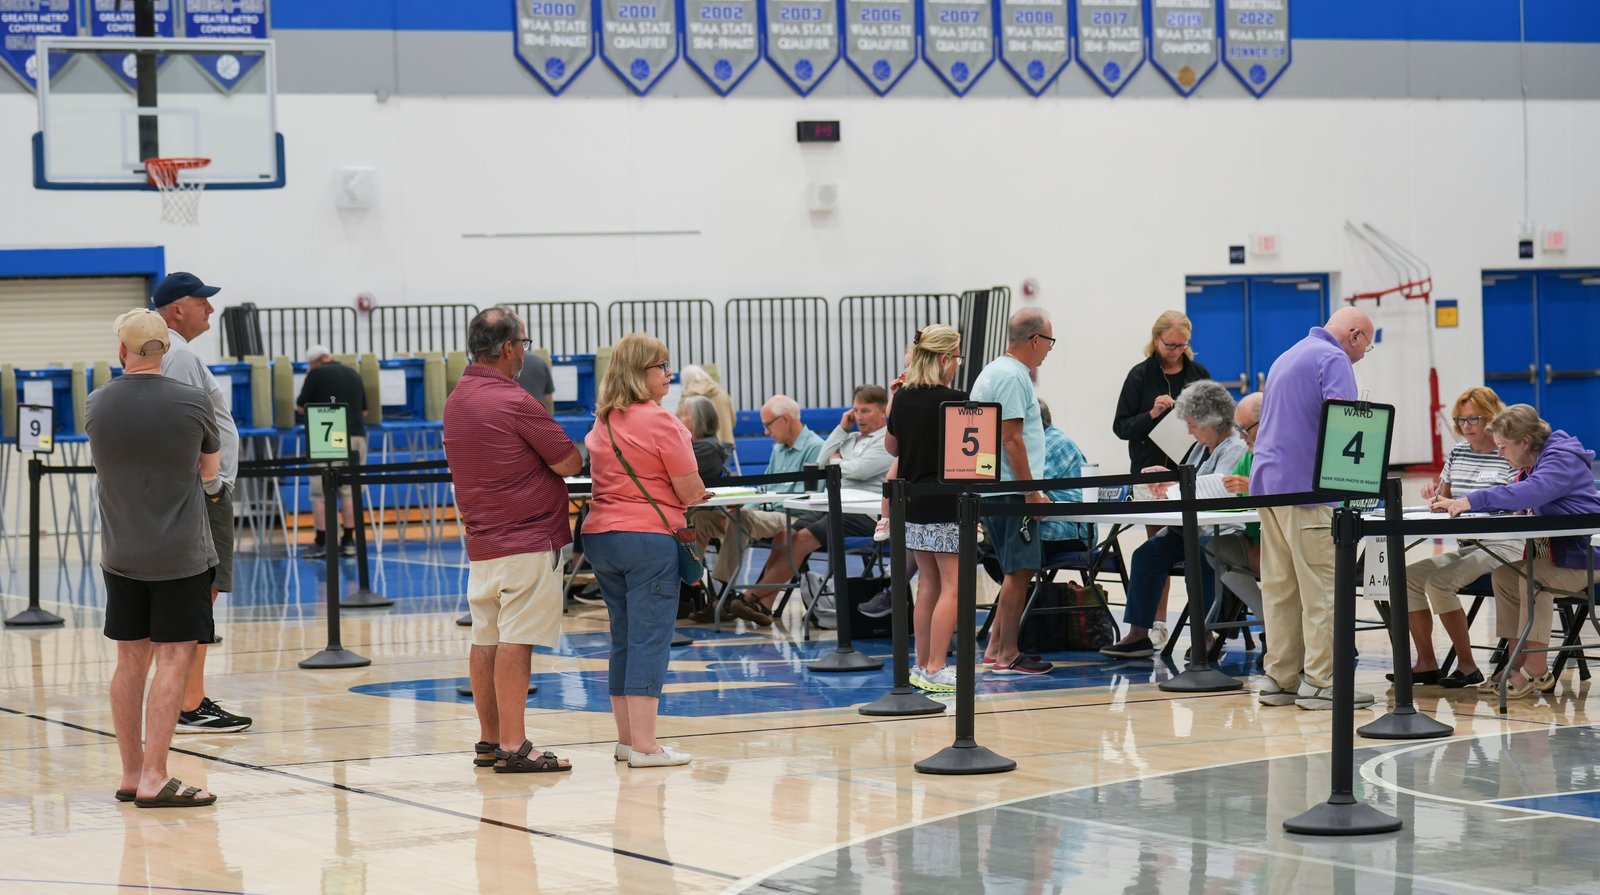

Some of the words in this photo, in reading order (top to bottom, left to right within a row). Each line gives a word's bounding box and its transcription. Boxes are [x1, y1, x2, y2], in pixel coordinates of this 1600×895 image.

[532, 2, 576, 16] 2000
[618, 5, 656, 18] 2001
[701, 6, 743, 19] 2002
[781, 7, 822, 20] 2003
[861, 8, 902, 22] 2006
[1, 13, 38, 22] GREATER
[40, 13, 69, 22] METRO
[193, 14, 229, 23] GREATER
[231, 14, 259, 24] METRO
[940, 9, 980, 23] 2007
[1093, 11, 1128, 25] 2017
[1239, 12, 1275, 25] 2022
[8, 23, 62, 33] CONFERENCE
[200, 24, 252, 34] CONFERENCE
[552, 20, 587, 33] STATE
[637, 22, 671, 34] STATE
[721, 23, 754, 35] STATE
[802, 23, 833, 35] STATE
[880, 24, 912, 37] STATE
[957, 26, 989, 38] STATE
[1034, 26, 1065, 39] STATE
[1109, 26, 1140, 39] STATE
[1183, 28, 1213, 40] STATE
[1255, 29, 1285, 42] STATE
[957, 408, 984, 416] WARD
[1343, 407, 1374, 419] WARD
[30, 419, 41, 437] 9
[320, 421, 334, 442] 7
[961, 427, 980, 457] 5
[1342, 430, 1365, 465] 4
[1379, 551, 1385, 563] 6
